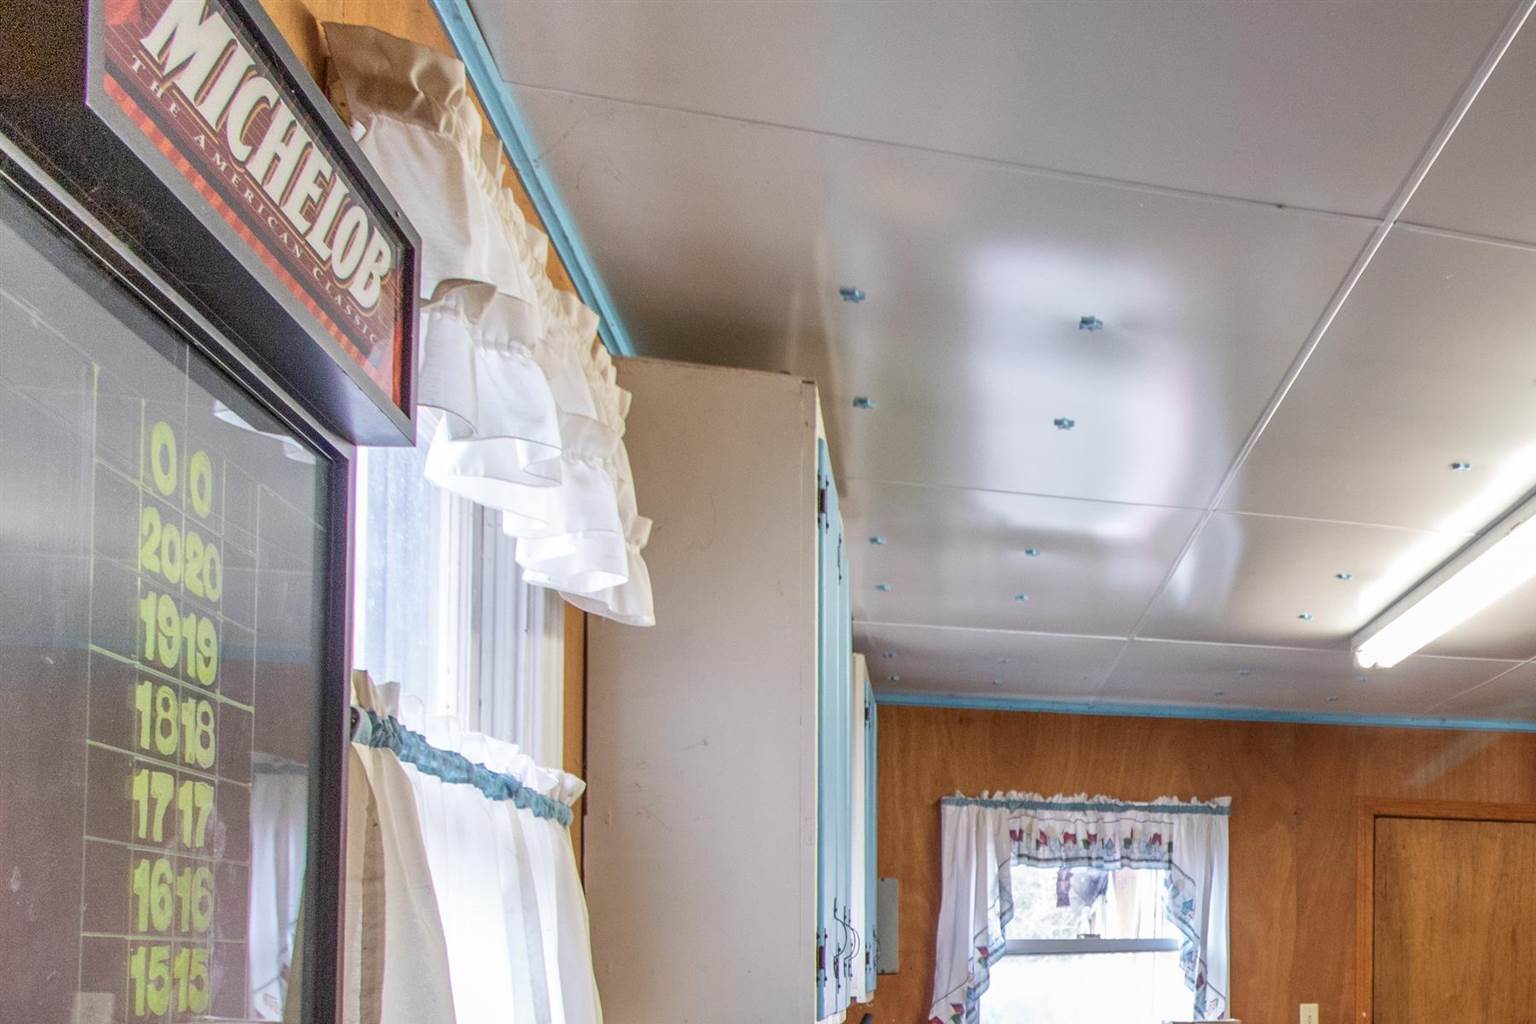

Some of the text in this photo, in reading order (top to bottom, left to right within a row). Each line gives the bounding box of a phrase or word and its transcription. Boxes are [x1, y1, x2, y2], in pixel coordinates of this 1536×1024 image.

[130, 54, 380, 344] THE AMERICAN CLASSIC
[140, 0, 392, 309] MICHELOB
